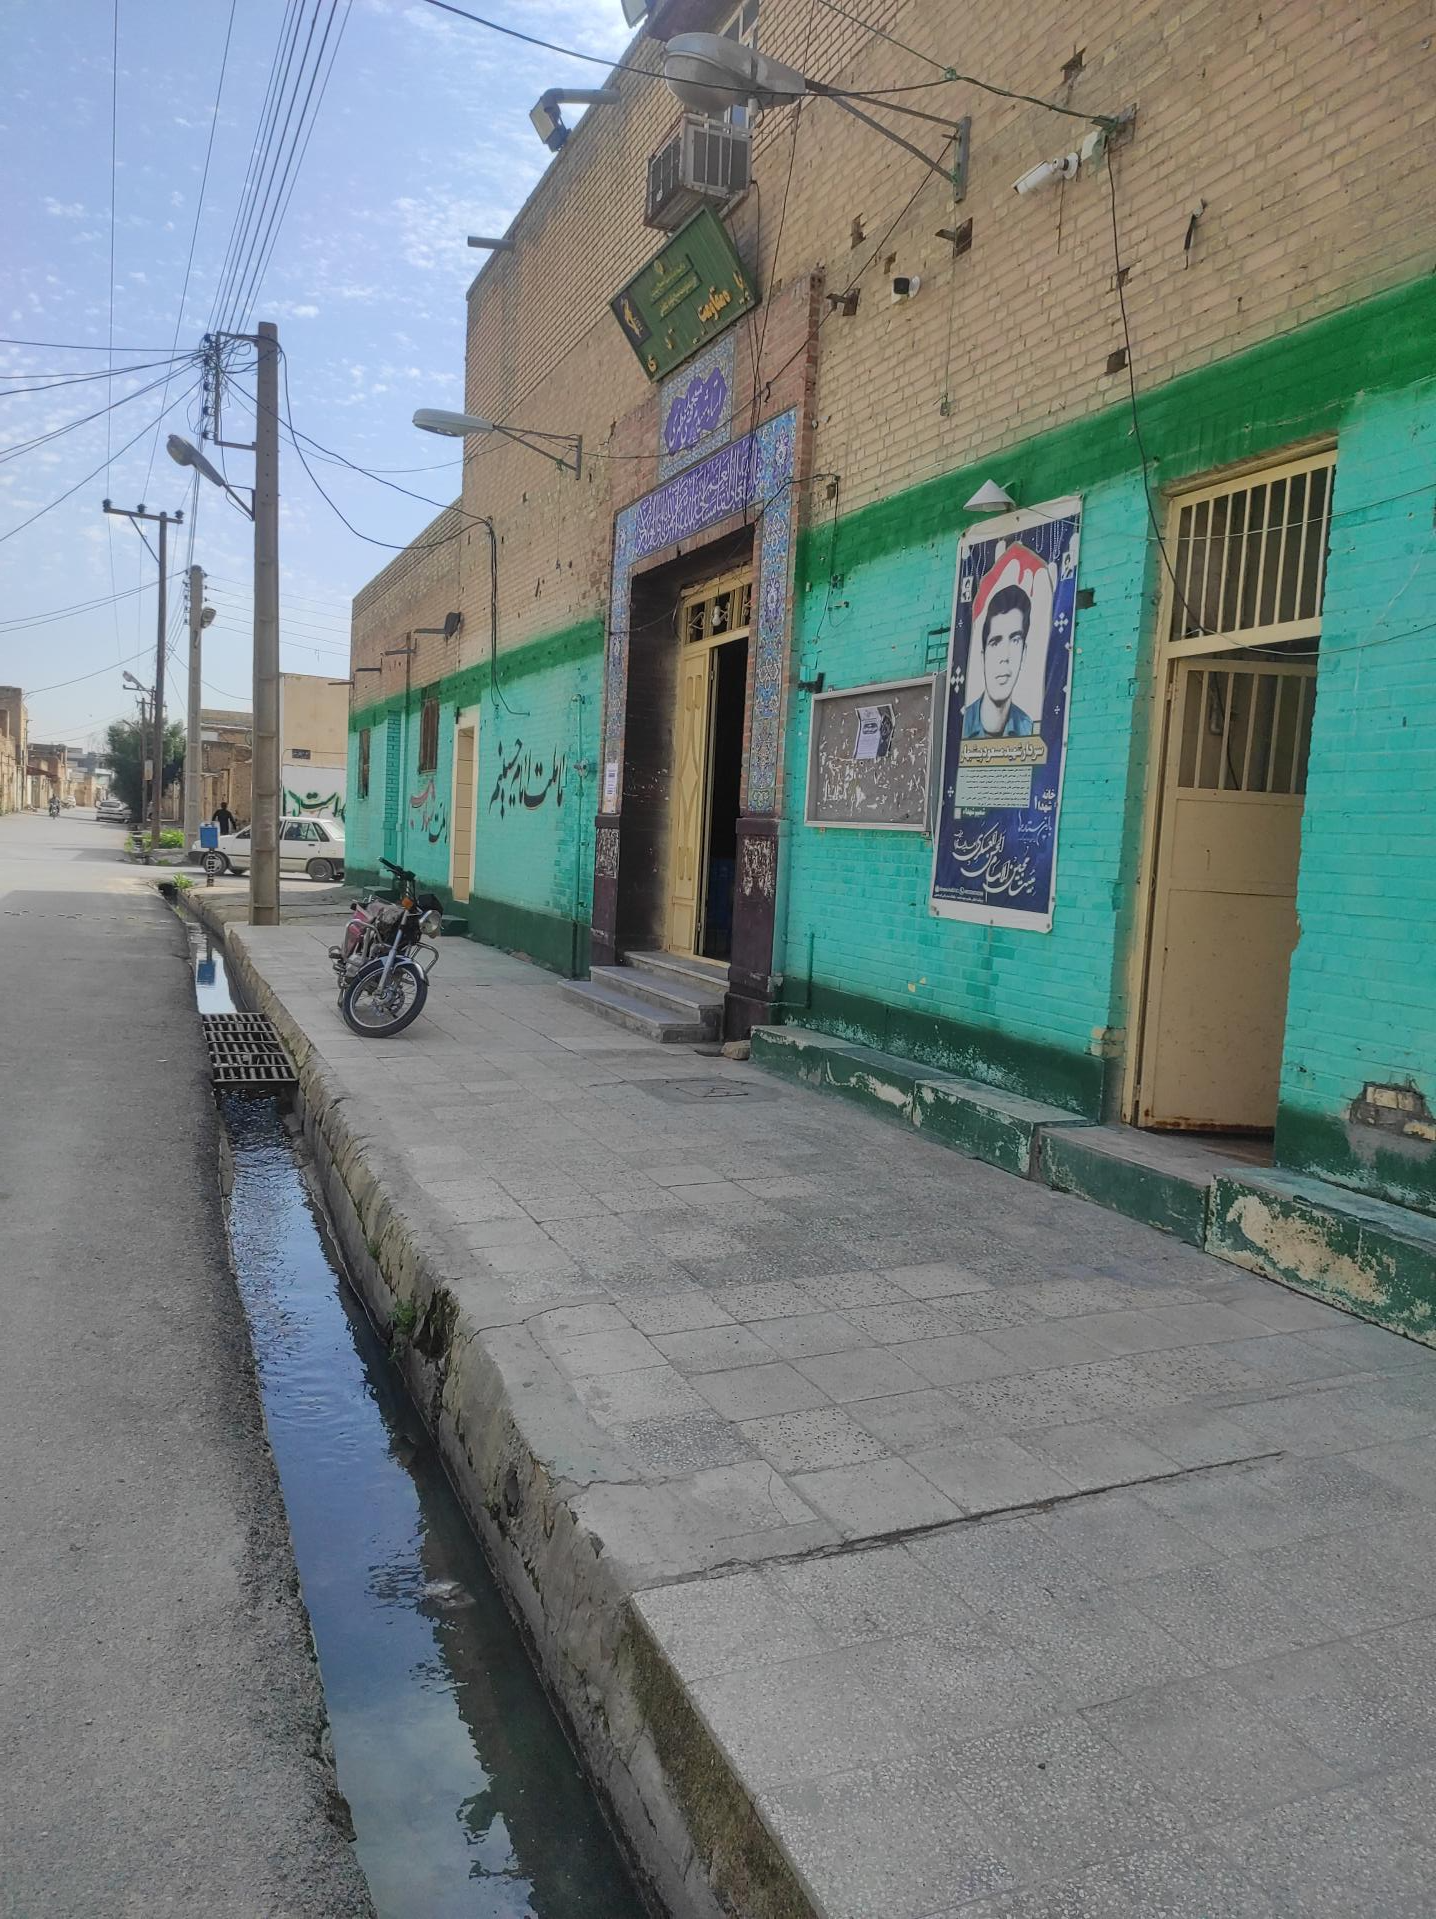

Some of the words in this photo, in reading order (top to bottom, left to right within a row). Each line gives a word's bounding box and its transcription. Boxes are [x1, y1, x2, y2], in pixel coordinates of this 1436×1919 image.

[699, 285, 732, 322] مقاومت
[1003, 745, 1022, 762] شهید
[1020, 743, 1045, 761] سردار
